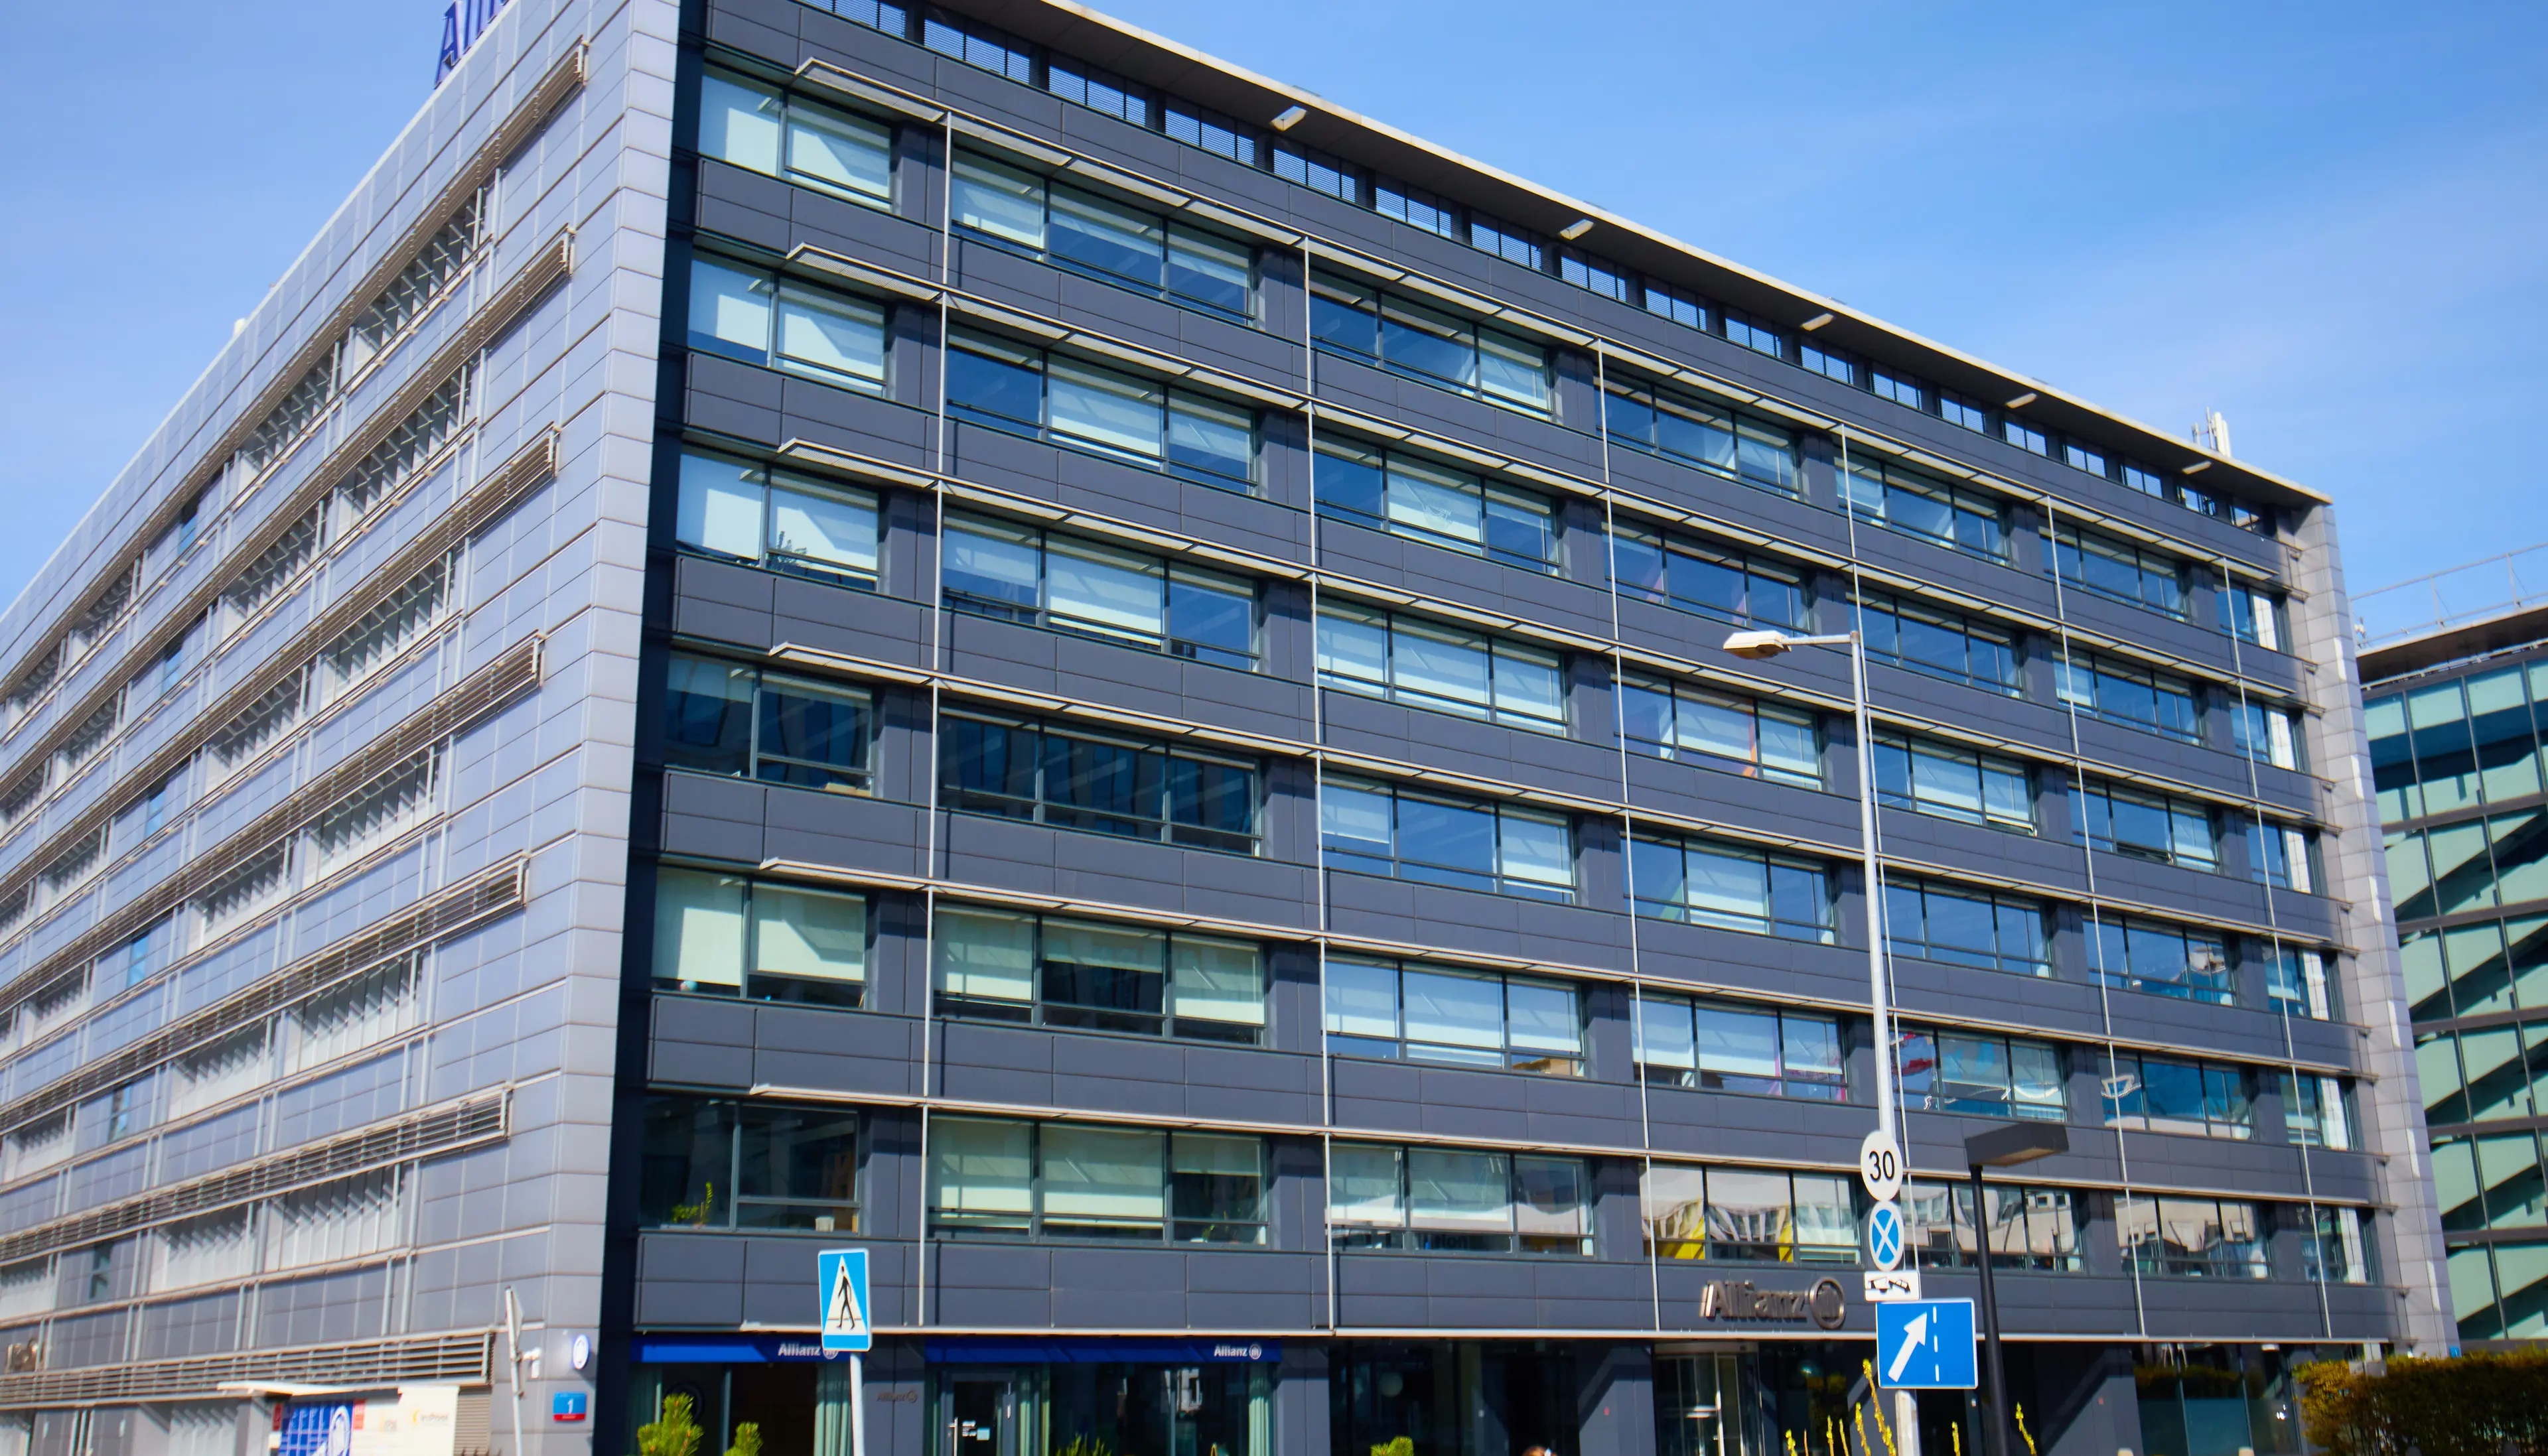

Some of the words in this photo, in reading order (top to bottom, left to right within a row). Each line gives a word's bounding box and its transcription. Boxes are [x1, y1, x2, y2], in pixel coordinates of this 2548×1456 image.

[1869, 1150, 1894, 1181] 30
[1704, 1280, 1807, 1321] Allianz
[778, 1342, 821, 1356] Allianz
[1214, 1344, 1247, 1357] Allianz
[567, 1398, 574, 1414] 1
